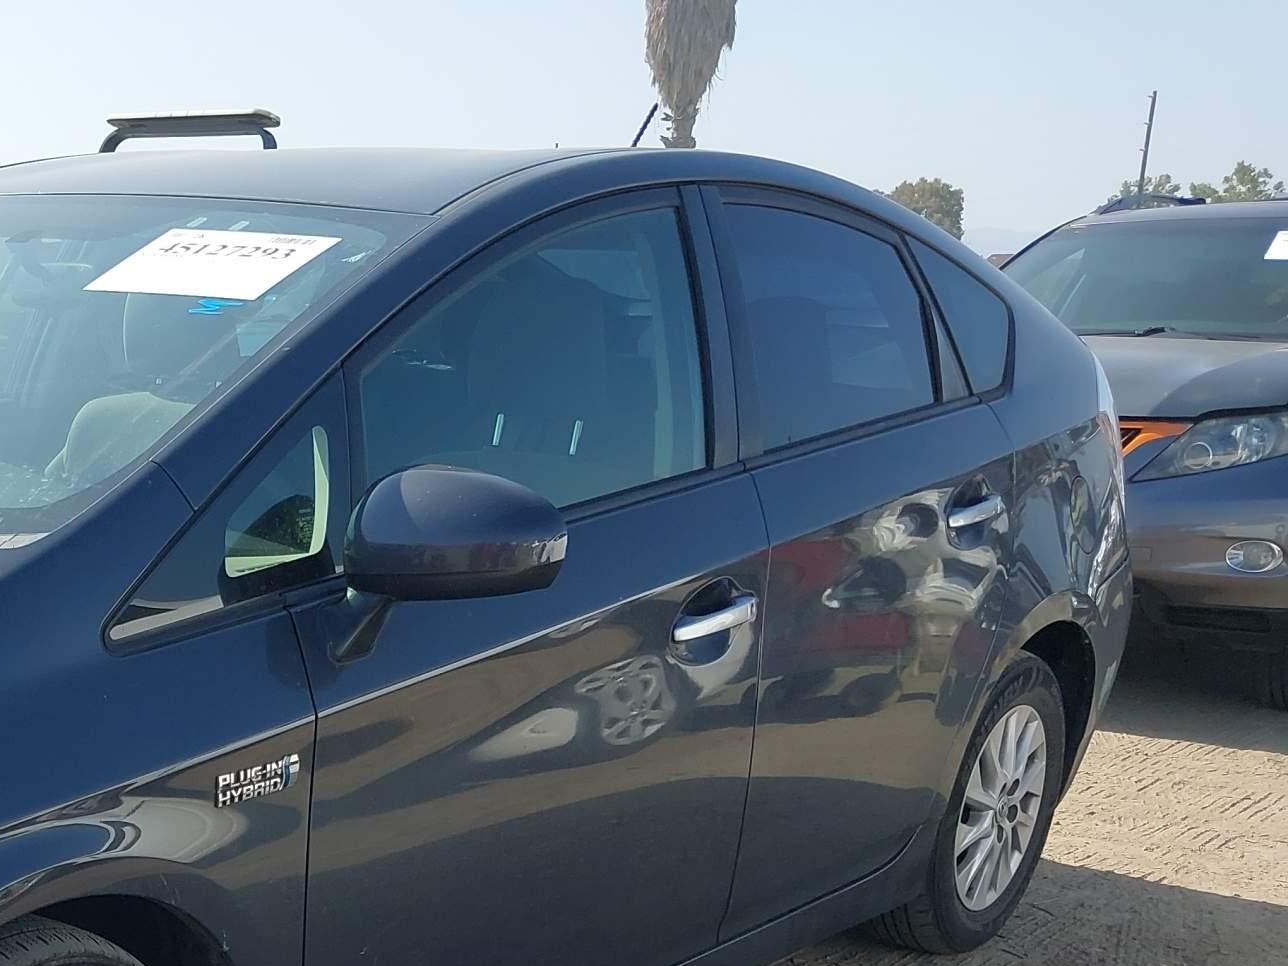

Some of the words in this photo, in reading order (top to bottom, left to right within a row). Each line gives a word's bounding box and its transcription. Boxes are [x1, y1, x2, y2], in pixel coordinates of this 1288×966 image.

[159, 242, 297, 260] 45127293
[218, 759, 283, 788] PLUG-IN
[218, 777, 281, 808] HYBRID
